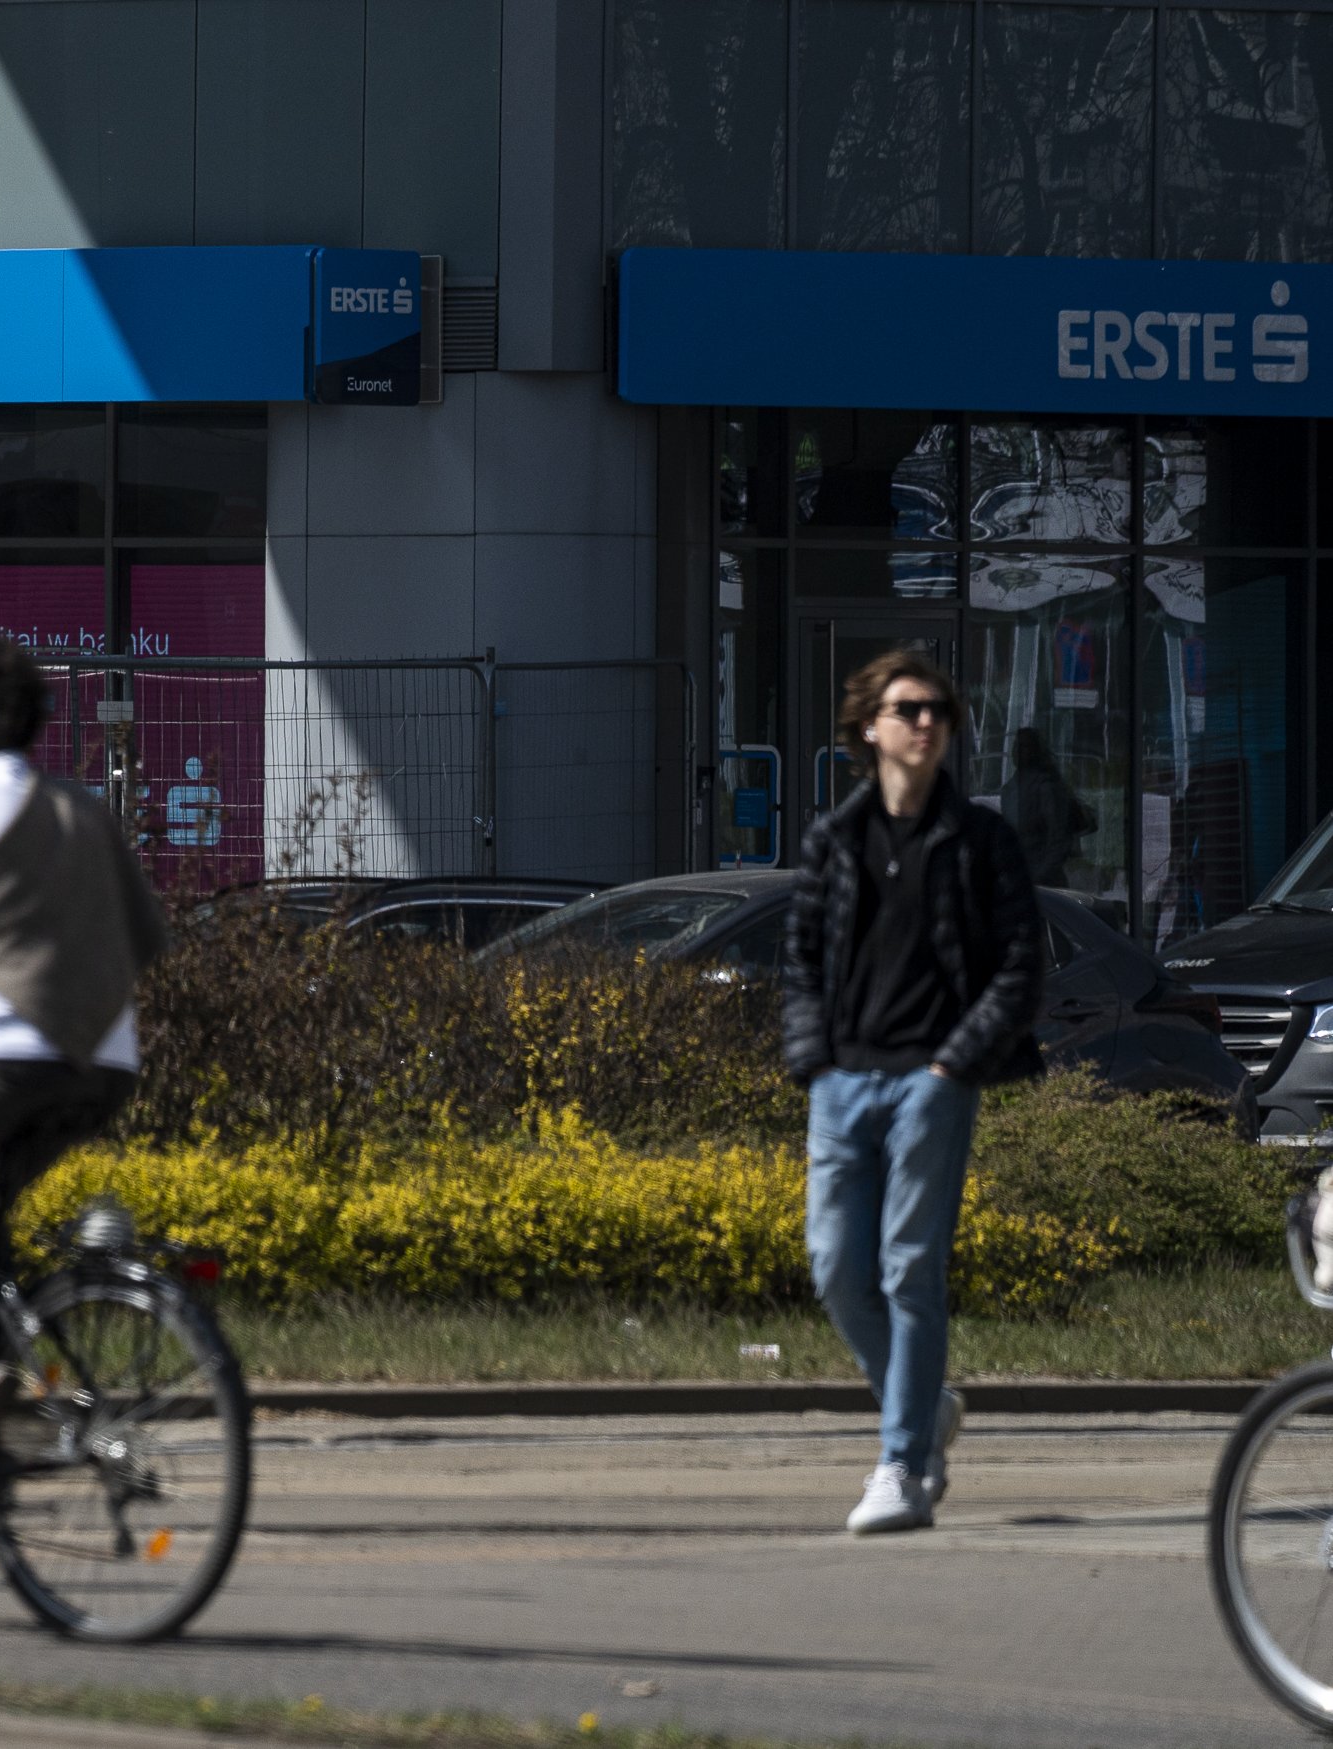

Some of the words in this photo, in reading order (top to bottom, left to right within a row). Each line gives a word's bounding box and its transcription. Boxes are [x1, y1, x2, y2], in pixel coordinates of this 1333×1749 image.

[330, 286, 390, 313] ERSTE
[1058, 310, 1236, 381] ERSTE
[347, 376, 394, 392] Euronet
